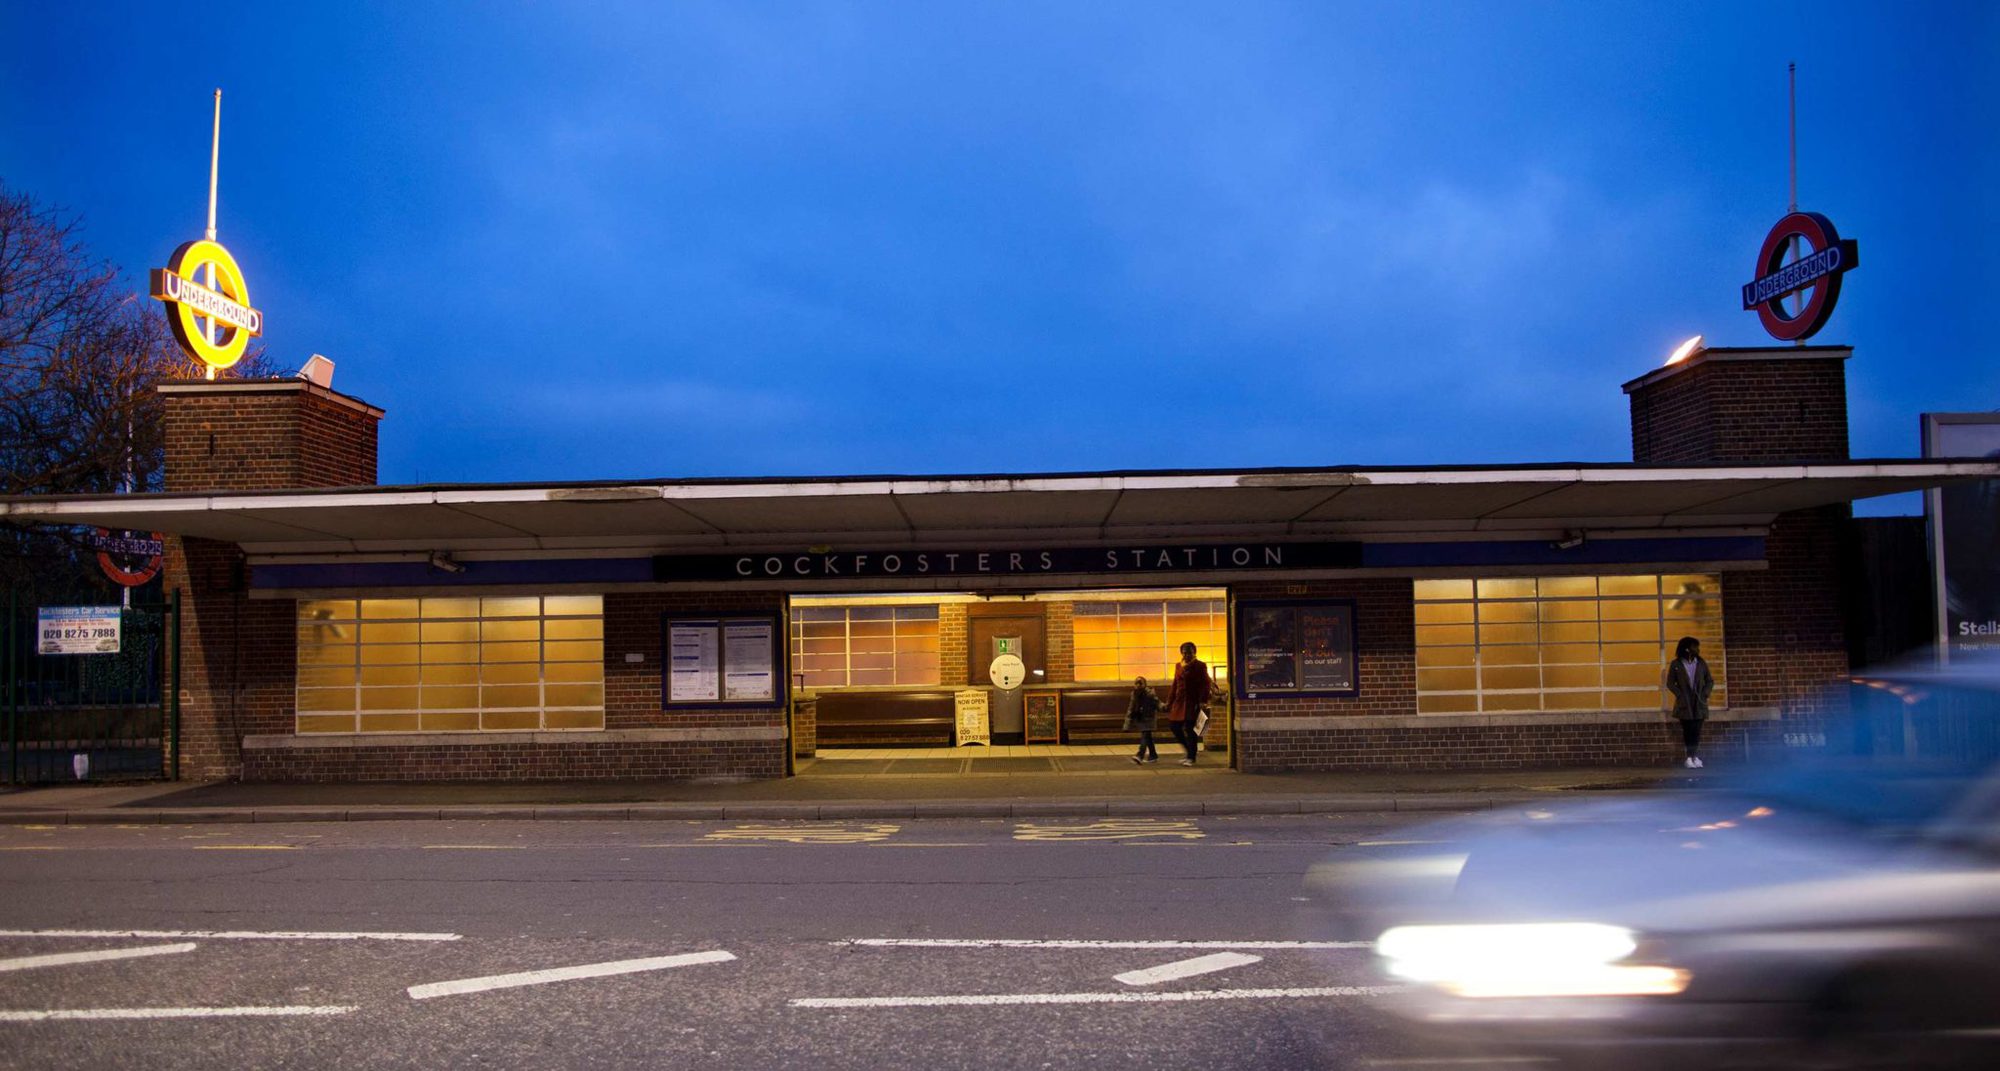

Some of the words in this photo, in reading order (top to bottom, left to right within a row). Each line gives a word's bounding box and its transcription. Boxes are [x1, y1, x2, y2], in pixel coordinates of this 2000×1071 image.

[1745, 246, 1841, 305] UNDERGROUND
[166, 272, 259, 333] UNDERGROUND
[736, 552, 1052, 575] COCKFOSTERS
[1107, 547, 1282, 570] STATION
[82, 607, 94, 615] Car
[95, 606, 121, 615] Service
[43, 629, 62, 639] 020
[65, 629, 89, 639] 8275
[92, 628, 116, 638] 7888
